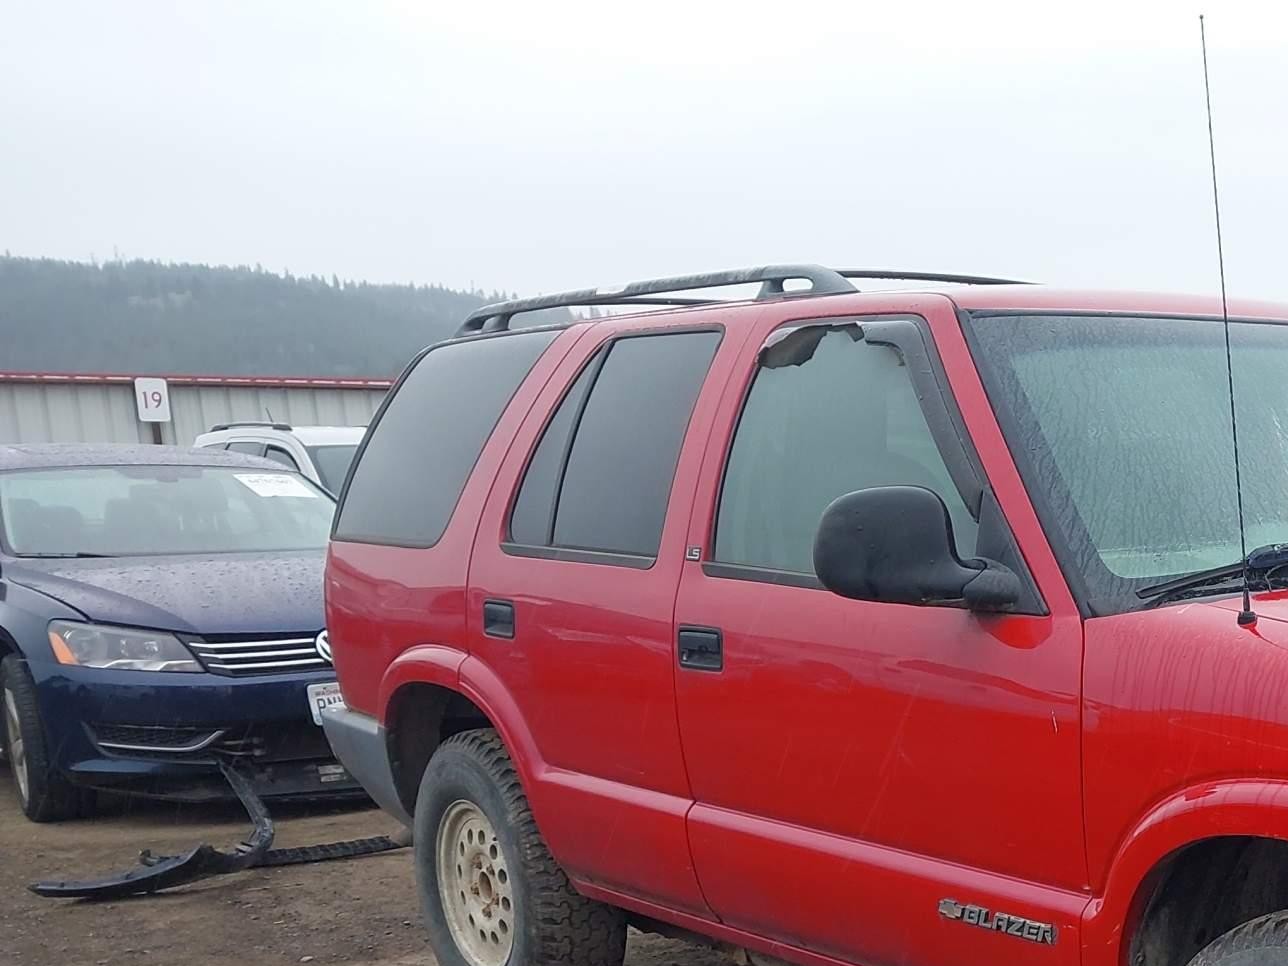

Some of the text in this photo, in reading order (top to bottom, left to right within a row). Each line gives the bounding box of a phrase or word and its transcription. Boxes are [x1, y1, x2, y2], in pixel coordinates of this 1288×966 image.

[142, 391, 162, 409] 19
[687, 547, 701, 560] LS
[962, 903, 1057, 945] BLAZER
